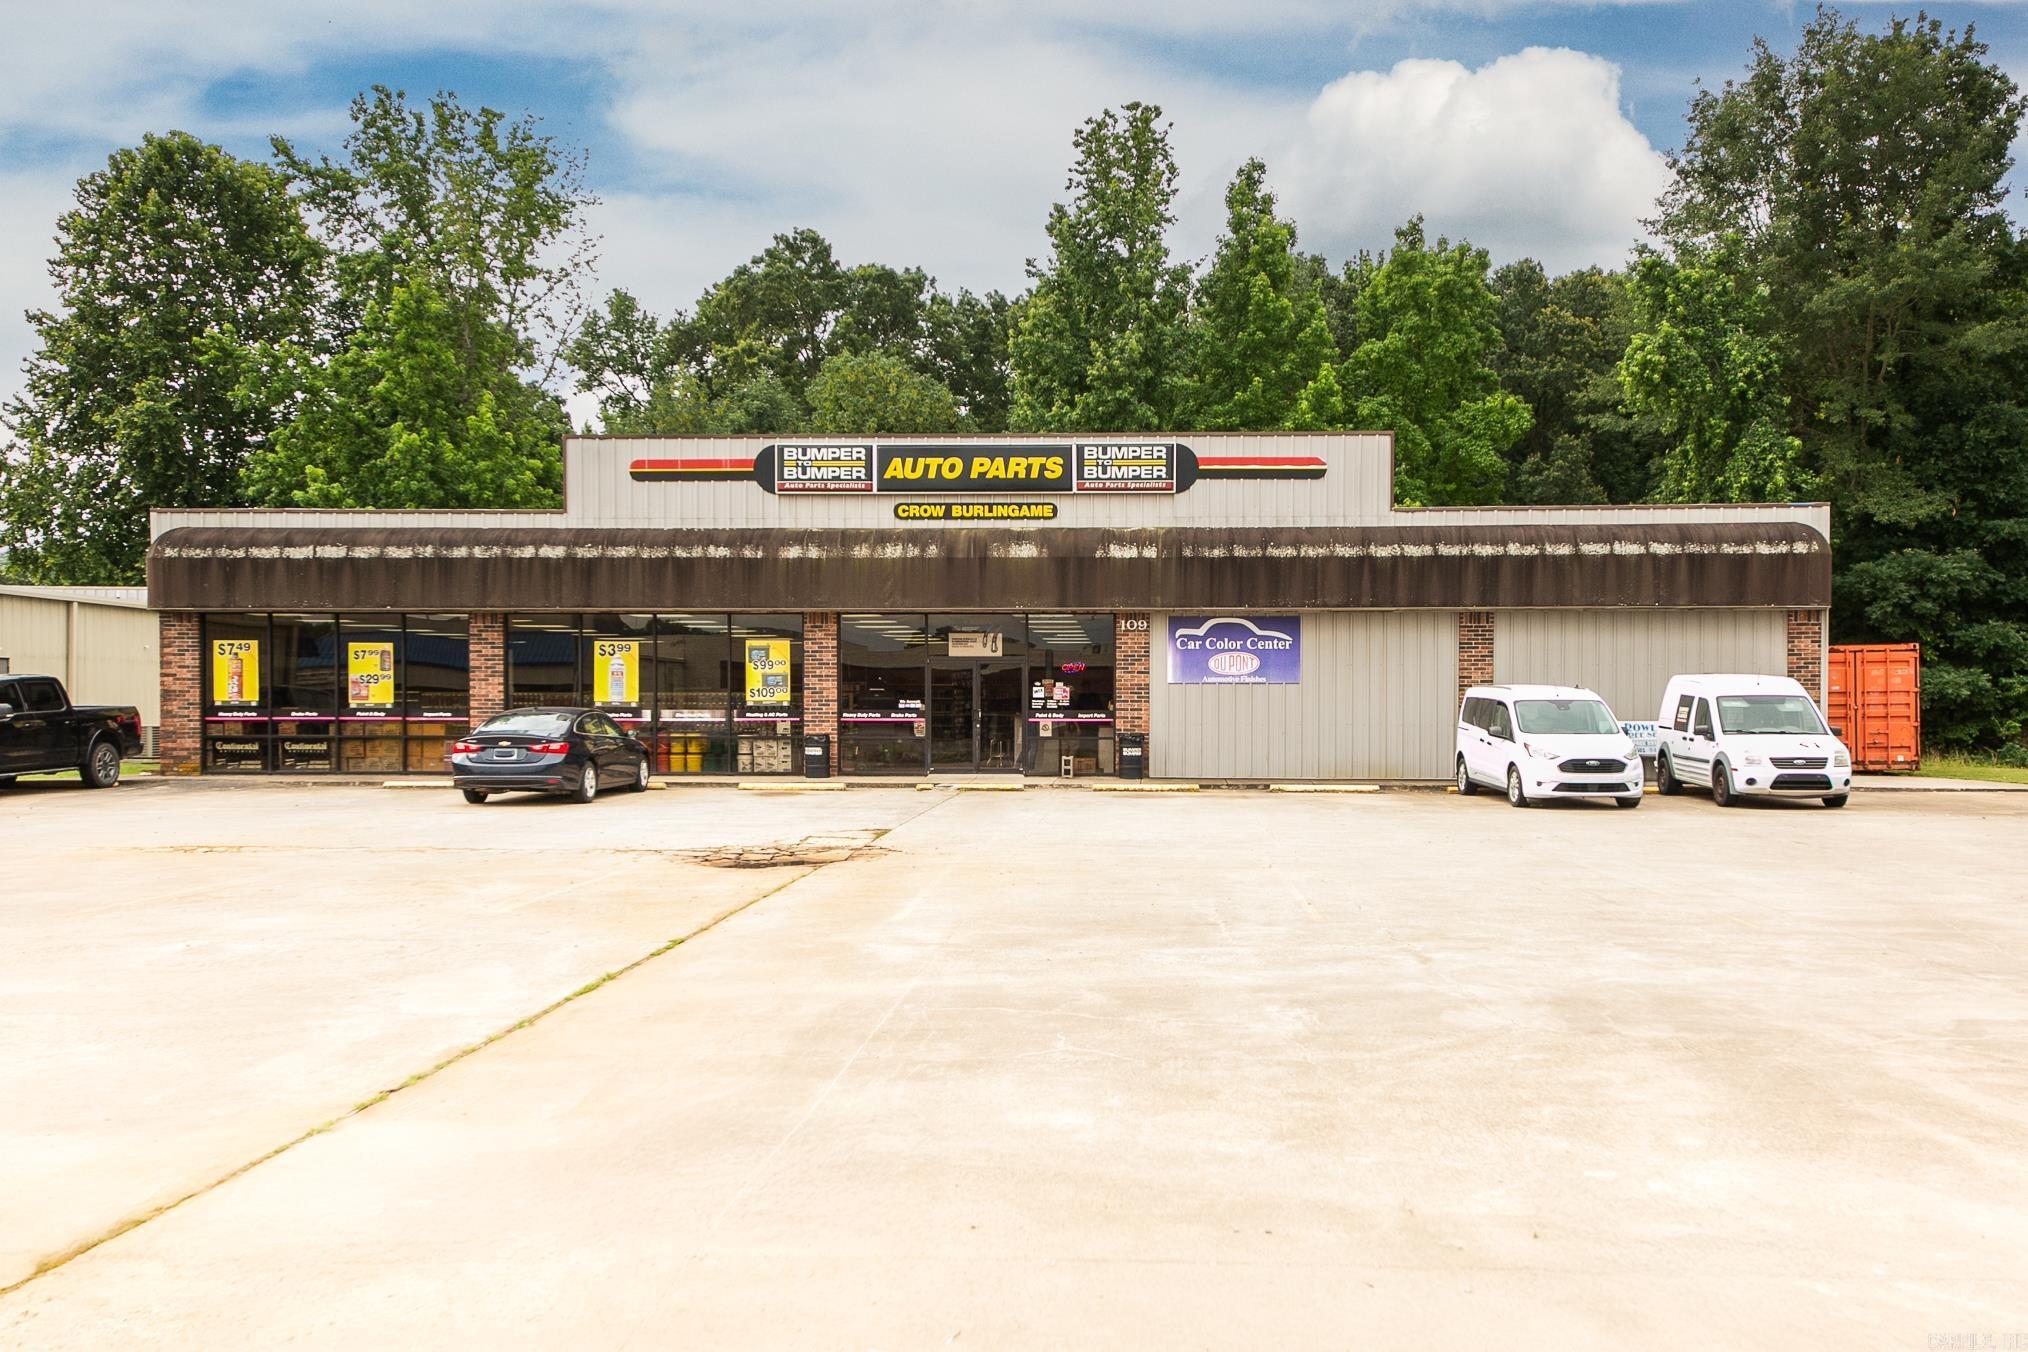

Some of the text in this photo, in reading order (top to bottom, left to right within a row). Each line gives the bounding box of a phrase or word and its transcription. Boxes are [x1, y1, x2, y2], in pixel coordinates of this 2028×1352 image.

[784, 447, 866, 460] BUMPER
[1083, 446, 1167, 459] BUMPER
[784, 466, 866, 480] BUMPER
[883, 456, 1064, 480] AUTO PARTS
[1083, 465, 1167, 479] BUMPER
[827, 482, 866, 490] Specialists
[1127, 481, 1167, 489] Specialists
[897, 504, 1054, 518] CROW BURLINGAME
[1120, 619, 1148, 631] 109
[1176, 637, 1294, 650] Car Color Center
[1061, 662, 1085, 672] OPEN
